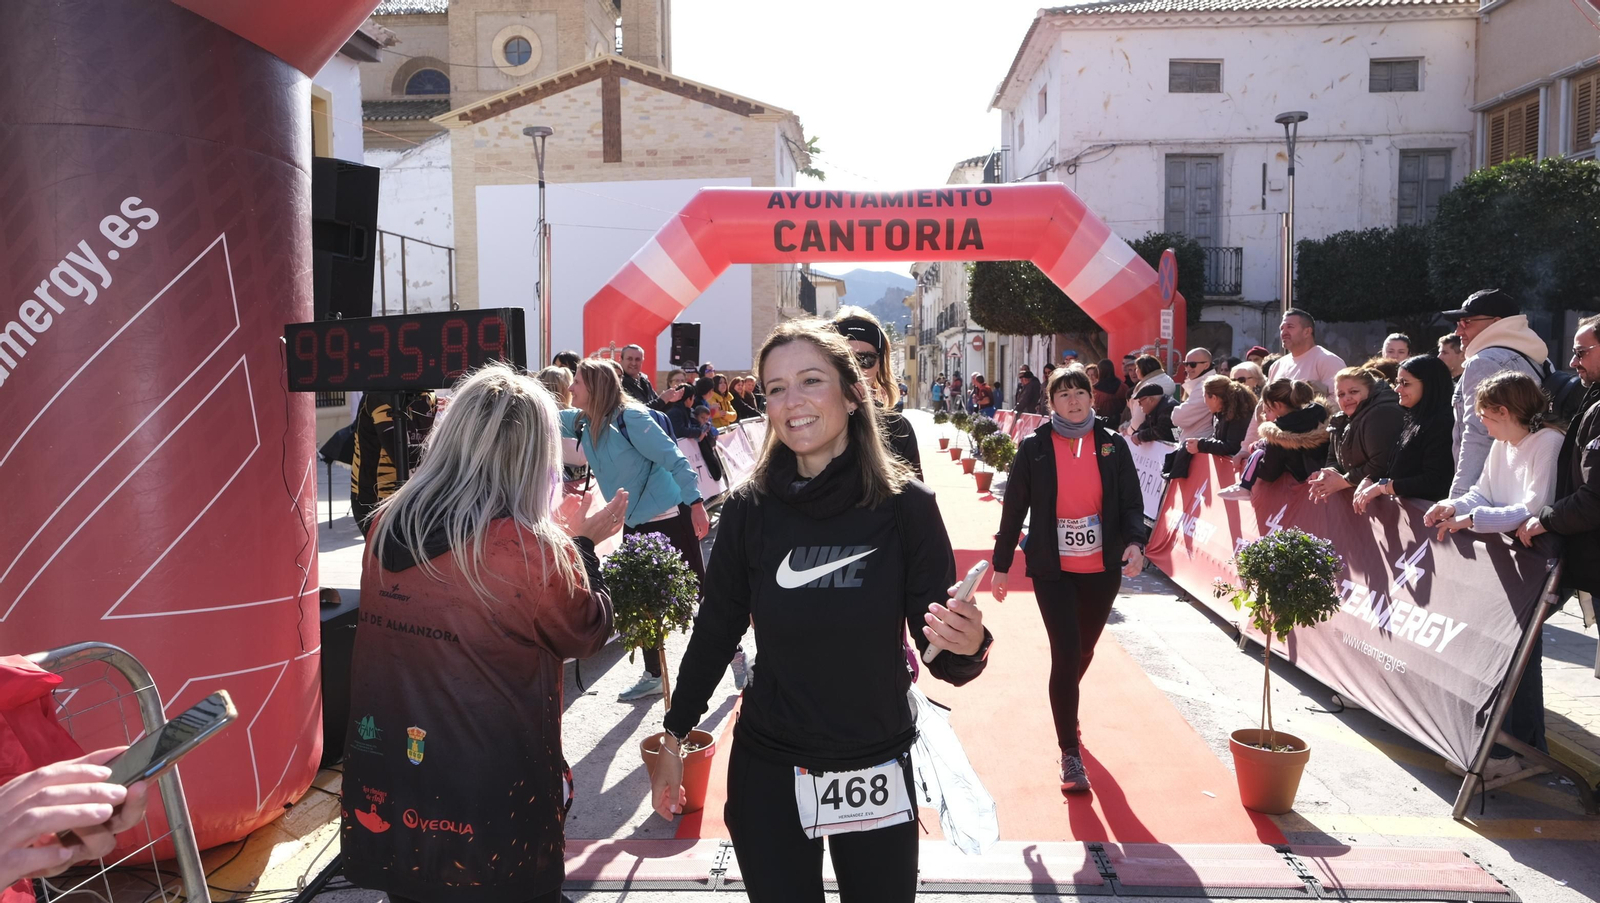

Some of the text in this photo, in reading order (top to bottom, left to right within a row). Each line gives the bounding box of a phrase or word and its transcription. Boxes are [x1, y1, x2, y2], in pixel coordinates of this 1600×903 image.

[767, 188, 993, 209] AYUNTAMIENTO
[774, 218, 985, 252] CANTORIA
[1065, 529, 1096, 546] 596
[789, 545, 873, 588] NIKE
[370, 614, 382, 626] DE
[386, 619, 461, 644] ALMANZORA
[1340, 579, 1468, 653] TEAMERGY
[820, 773, 889, 810] 468
[419, 818, 474, 835] VEOLIA
